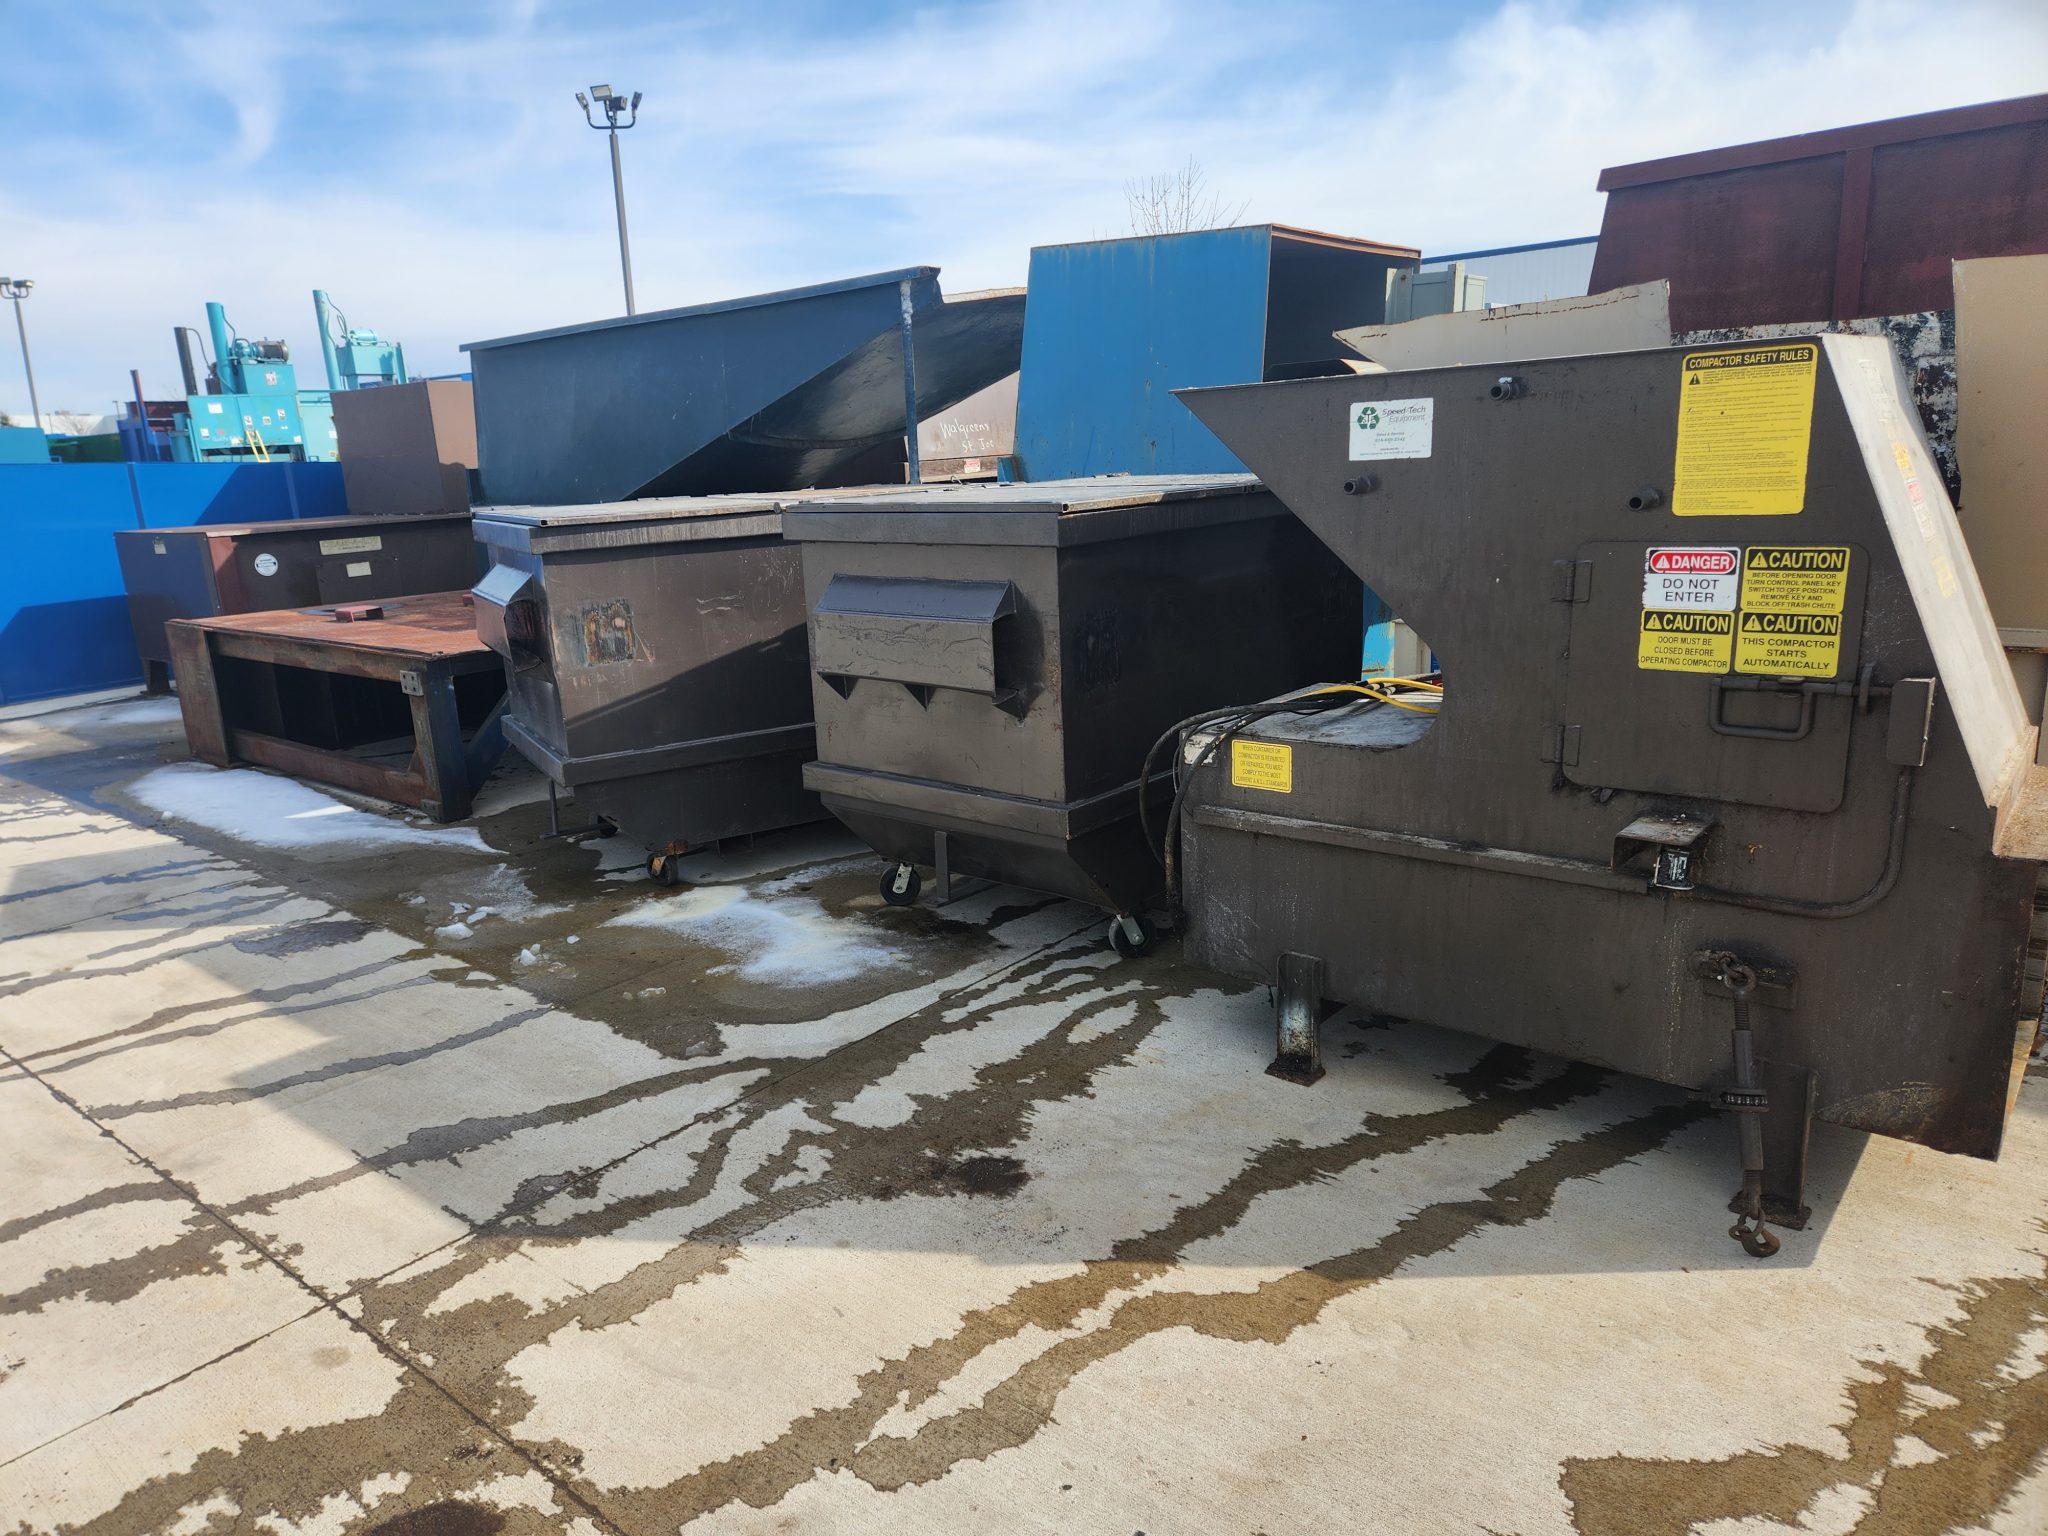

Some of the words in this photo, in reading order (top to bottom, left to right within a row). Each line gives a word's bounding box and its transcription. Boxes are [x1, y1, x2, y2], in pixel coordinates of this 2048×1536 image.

[1689, 356, 1742, 369] COMPACTOR
[1743, 352, 1778, 364] SAFETY
[1779, 349, 1810, 361] RULES
[1389, 414, 1426, 424] Equipment
[939, 418, 990, 439] Walgreens
[978, 438, 995, 450] Joe
[1671, 555, 1731, 570] DANGER
[1769, 551, 1844, 569] CAUTION
[1662, 578, 1684, 589] DO
[1688, 579, 1720, 590] NOT
[1665, 591, 1715, 603] ENTER
[1662, 613, 1729, 633] CAUTION
[1763, 614, 1838, 634] CAUTION
[1657, 635, 1679, 644] DOOR
[1680, 636, 1701, 645] MUST
[1702, 638, 1713, 646] BE
[1742, 637, 1765, 646] THIS
[1767, 638, 1835, 649] COMPACTOR
[1654, 646, 1683, 655] CLOSED
[1684, 647, 1715, 657] BEFORE
[1766, 649, 1807, 658] STARTS
[1640, 655, 1682, 666] OPERATING
[1682, 658, 1728, 669] COMPACTOR
[1743, 658, 1831, 670] AUTOMATICALLY
